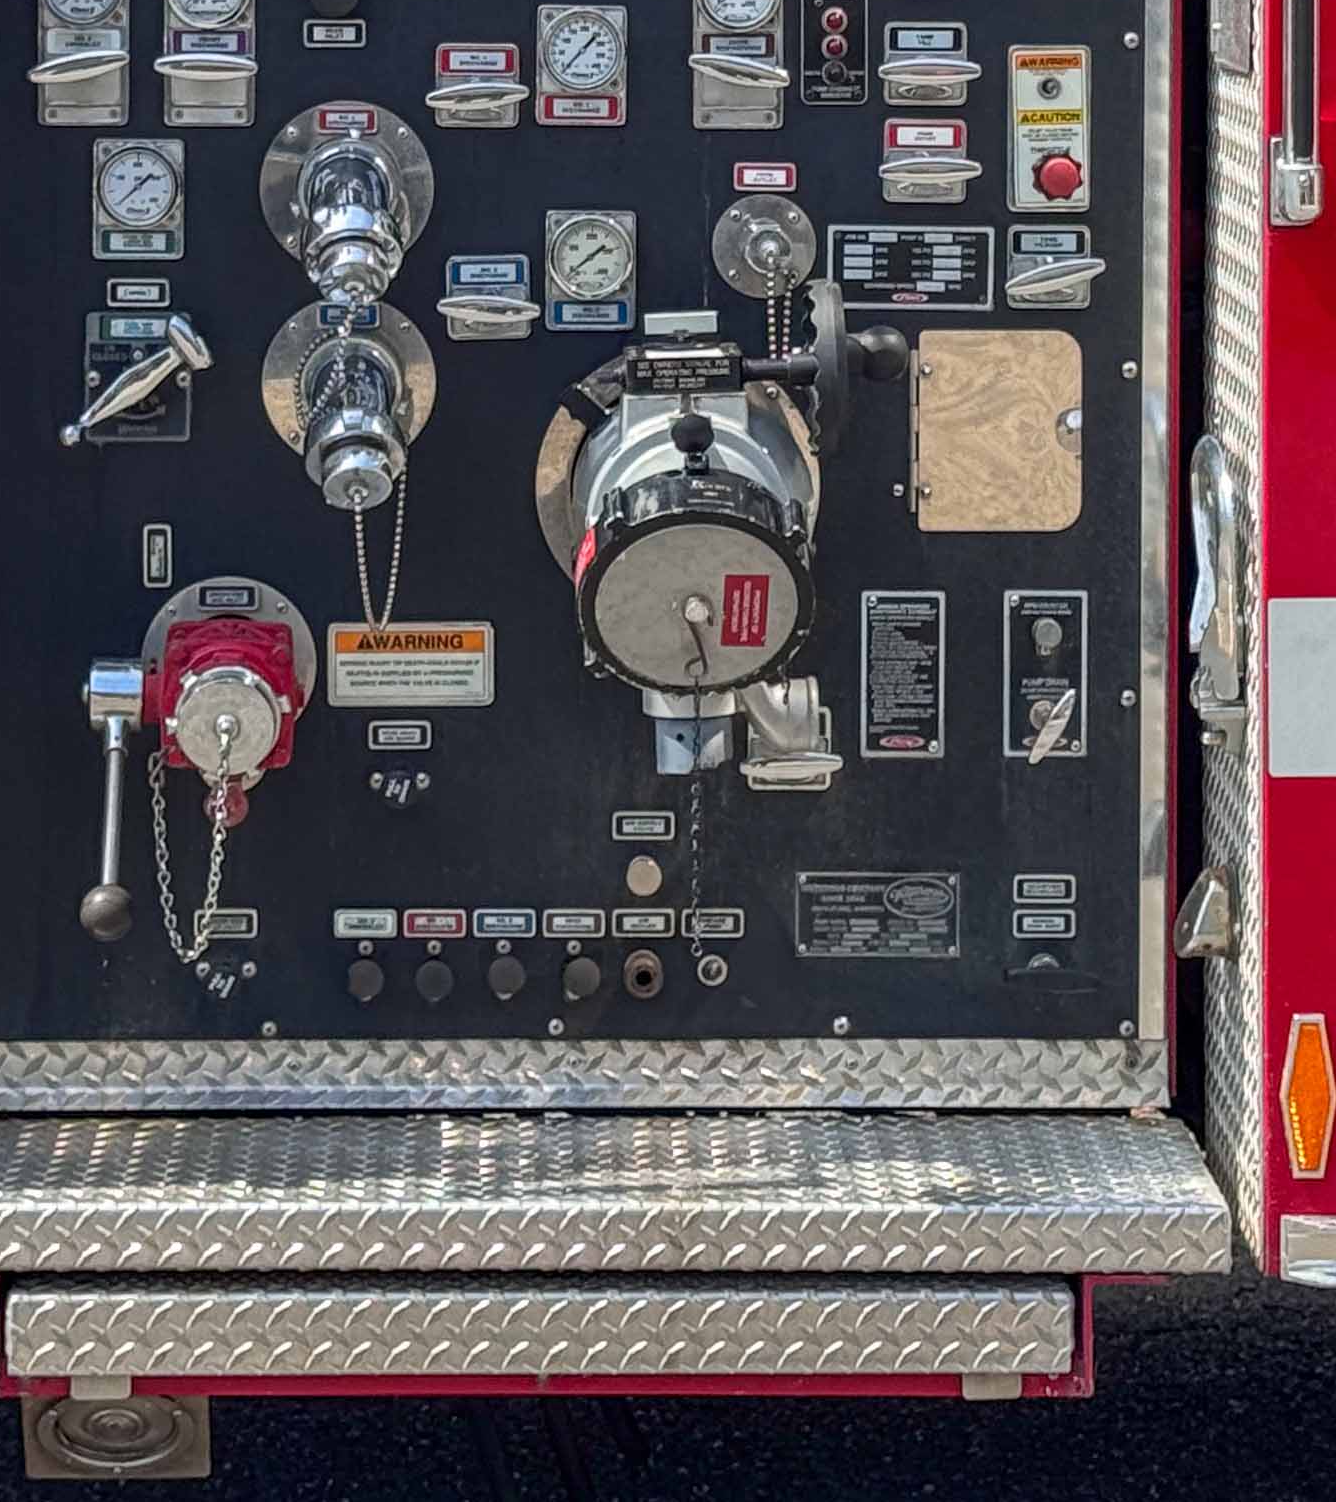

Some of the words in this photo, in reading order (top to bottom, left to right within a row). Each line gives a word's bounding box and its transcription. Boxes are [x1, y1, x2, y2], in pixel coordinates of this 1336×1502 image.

[1027, 57, 1080, 67] WARNING
[1030, 114, 1080, 123] CAUTION
[372, 634, 464, 649] WARNING
